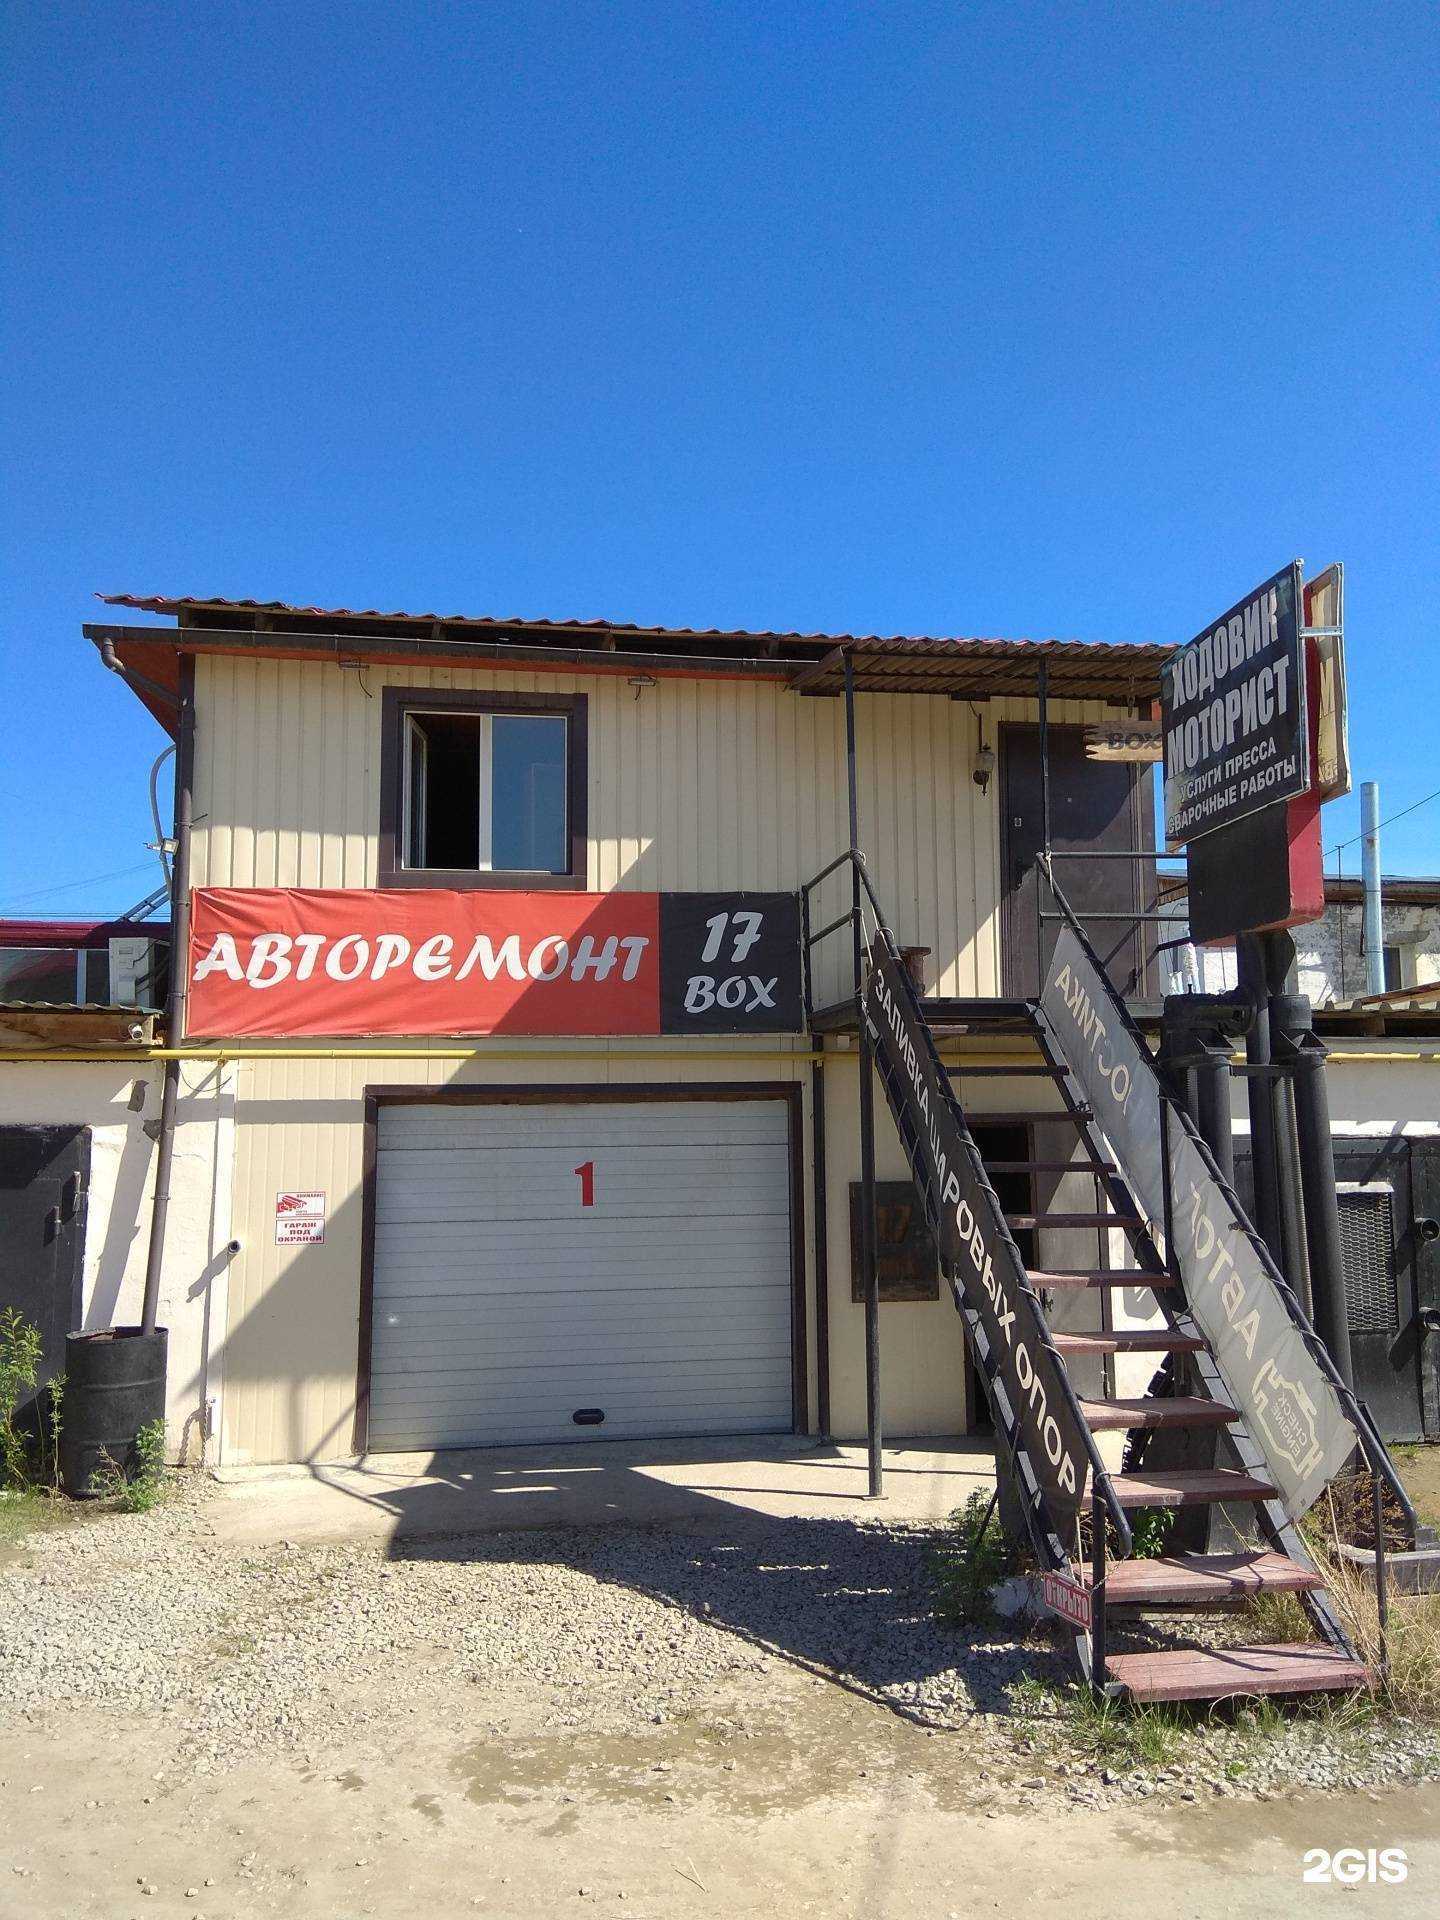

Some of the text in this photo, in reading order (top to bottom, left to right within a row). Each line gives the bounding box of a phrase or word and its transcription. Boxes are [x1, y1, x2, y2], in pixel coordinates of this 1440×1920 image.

[1172, 587, 1278, 711] ХОДОВИК
[1167, 655, 1289, 780] МОТОРИСТ
[1167, 755, 1296, 834] СВАРОЧНЫЕ РАБОТЫ
[1178, 736, 1276, 803] УСЛУГИ ПРЕССА
[192, 932, 650, 988] АВТОРЕМОНТ
[700, 911, 764, 964] 17
[684, 975, 779, 1014] BOX
[573, 1161, 594, 1207] 1
[876, 969, 930, 1126] ЗАЛИВКА
[1015, 1343, 1078, 1496] ОПОР
